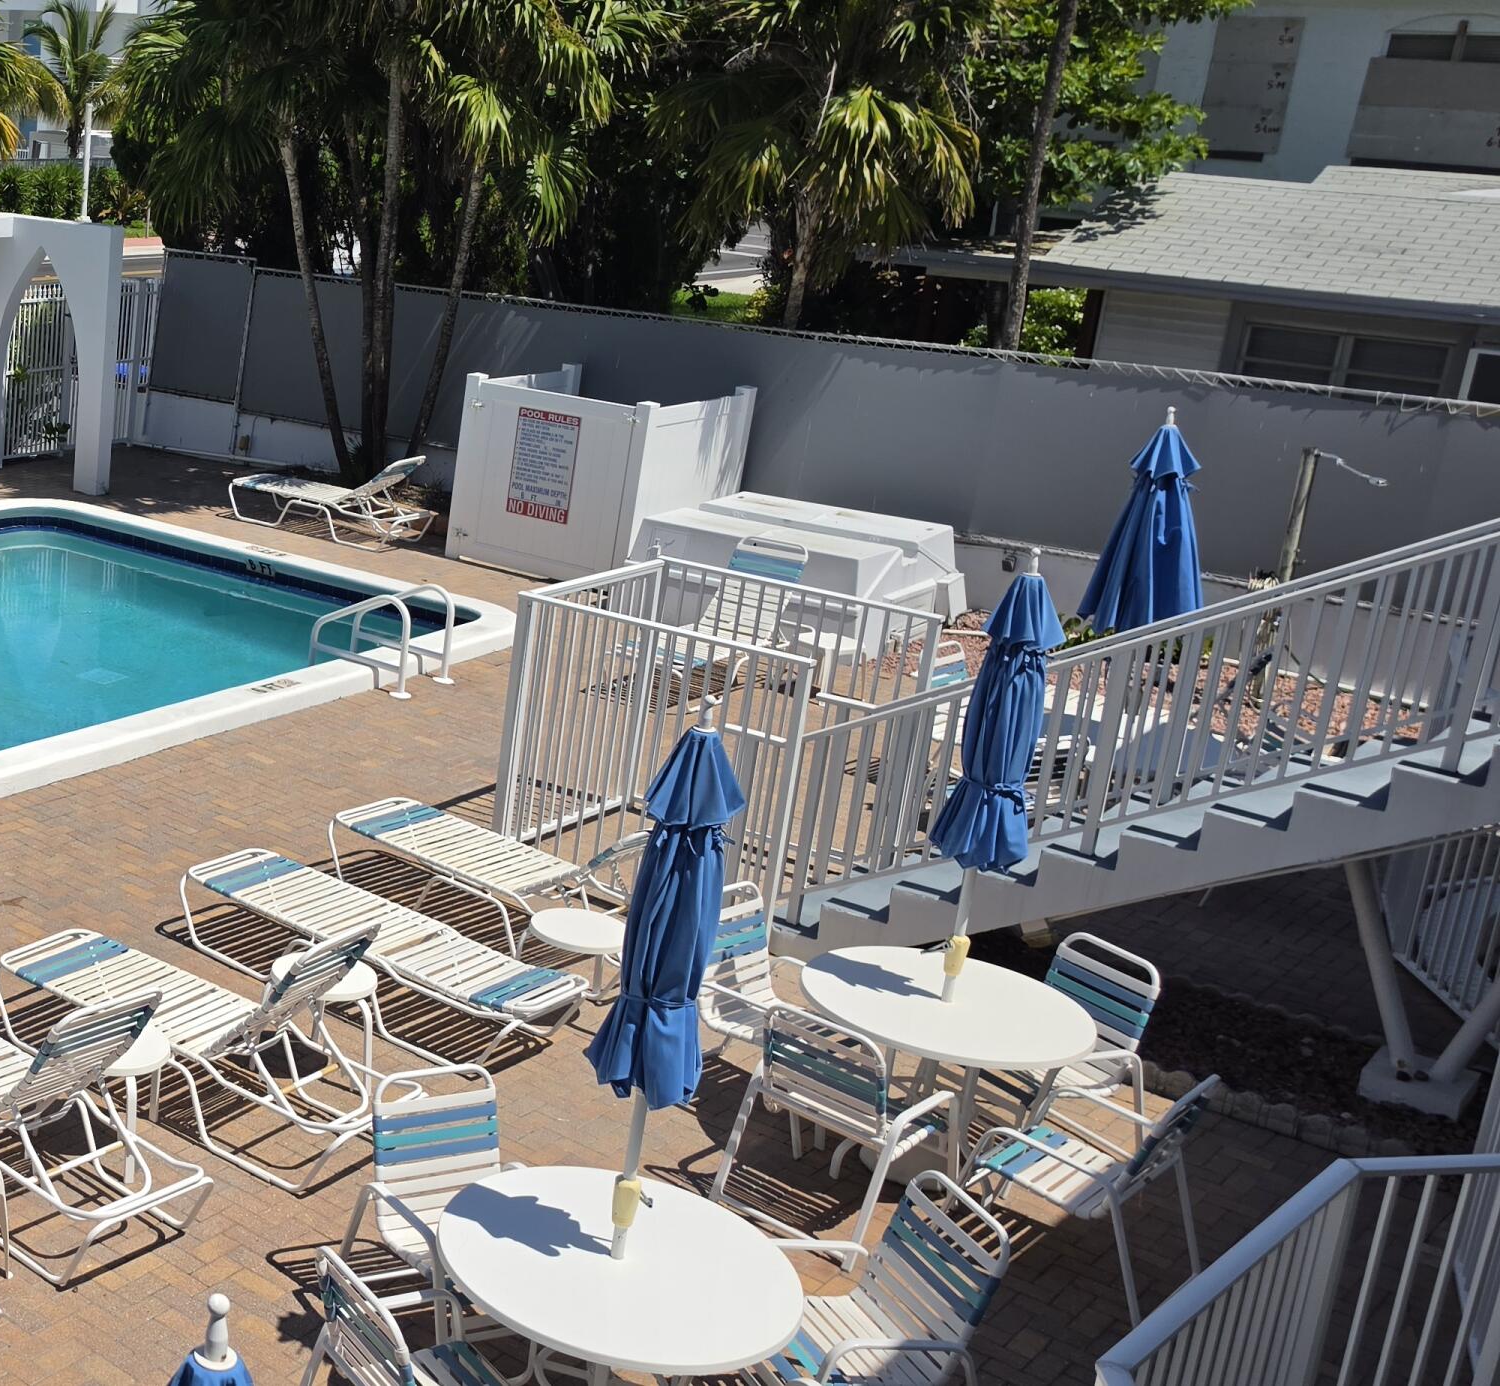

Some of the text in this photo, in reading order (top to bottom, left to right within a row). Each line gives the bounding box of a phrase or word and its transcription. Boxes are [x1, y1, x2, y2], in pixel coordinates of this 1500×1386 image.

[520, 408, 546, 420] POOL
[548, 413, 579, 425] RULES
[512, 482, 524, 491] POOL
[525, 484, 550, 496] MAXIMUM
[508, 499, 565, 523] NO DIVING
[258, 561, 272, 576] FT
